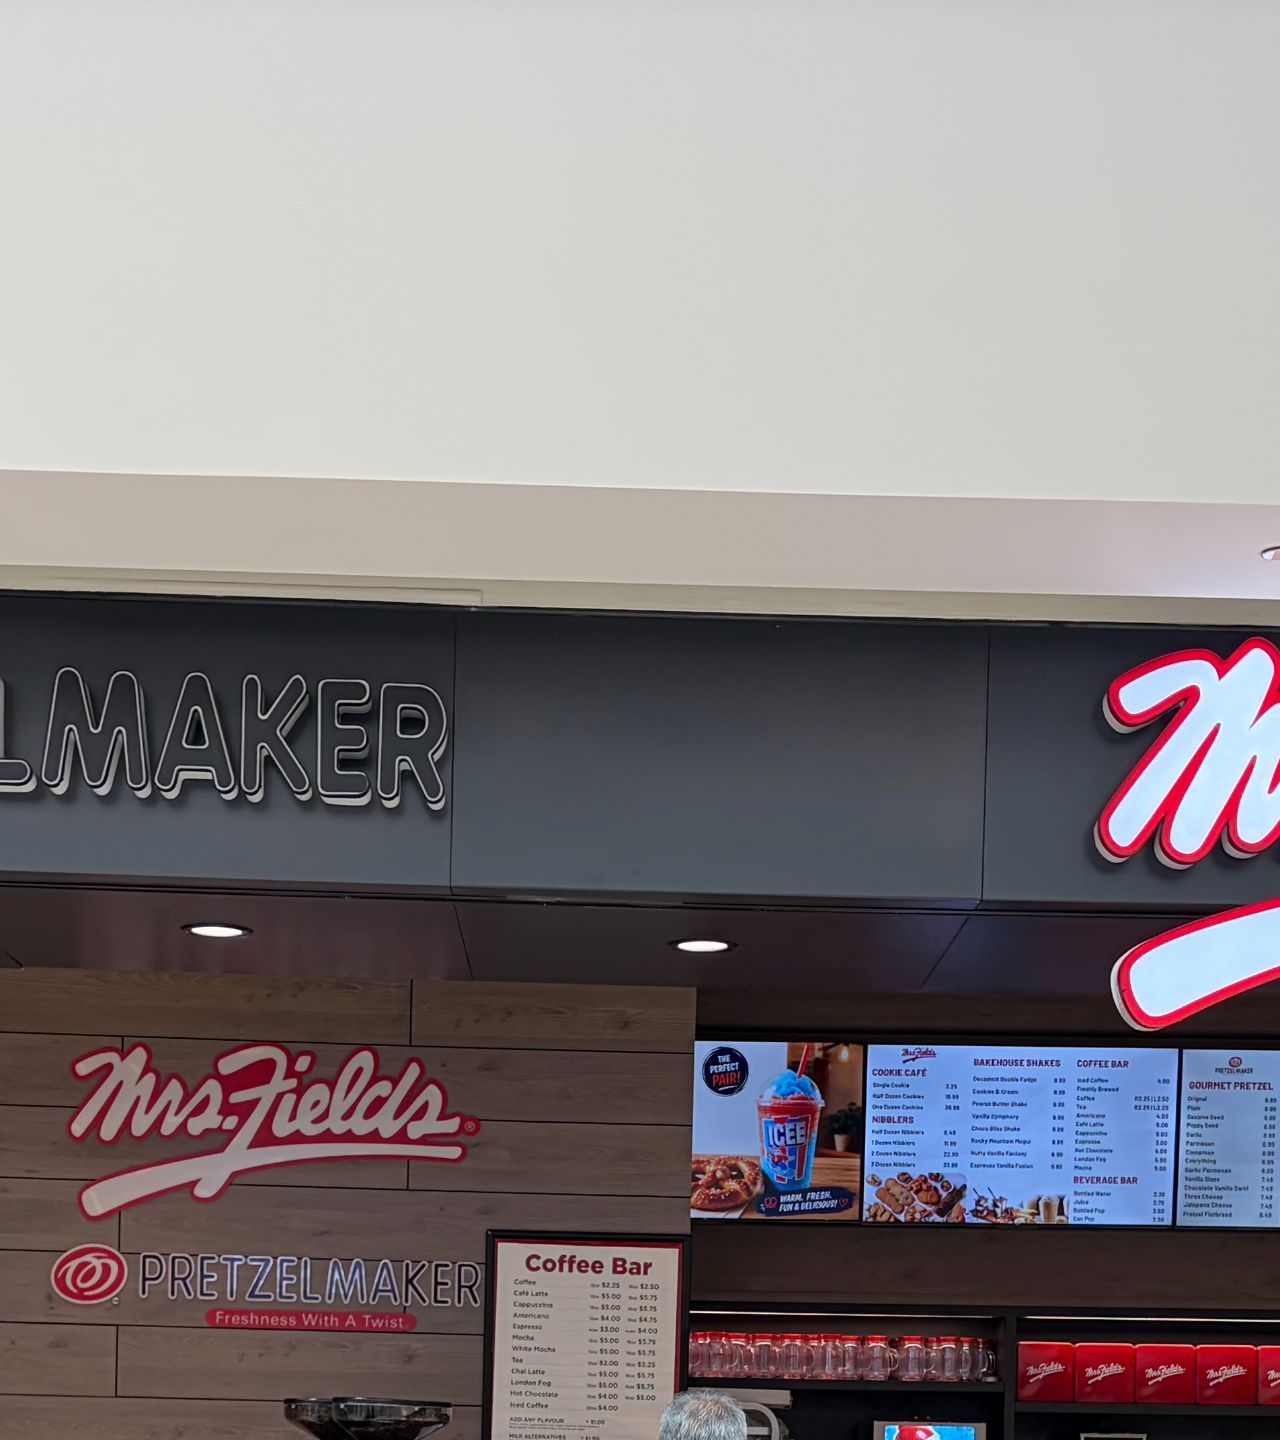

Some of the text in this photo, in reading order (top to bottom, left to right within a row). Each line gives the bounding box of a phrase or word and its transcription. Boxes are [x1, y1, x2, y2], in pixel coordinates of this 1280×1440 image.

[717, 1054, 731, 1063] THE
[973, 1058, 1061, 1067] BAKEHOUSE SHAKES
[709, 1062, 740, 1074] PERFECT
[1077, 1060, 1129, 1069] COFFEE BAR
[872, 1068, 903, 1077] COOKIE
[712, 1073, 741, 1087] PAIR!
[1189, 1081, 1274, 1091] GOURMET PRETZEL
[768, 1120, 807, 1148] ICEE
[1073, 1176, 1138, 1185] BEVERAGE BAR
[525, 1254, 653, 1276] Coffee Bar
[138, 1253, 481, 1307] PRETZELMAKER
[513, 1278, 536, 1286] Coffee
[215, 1311, 405, 1330] Freshness With A Twist
[513, 1312, 549, 1320] Americano
[512, 1323, 543, 1331] Espresso
[512, 1356, 523, 1364] Tea
[510, 1379, 552, 1388] London Fog
[524, 1390, 559, 1398] Chocolate
